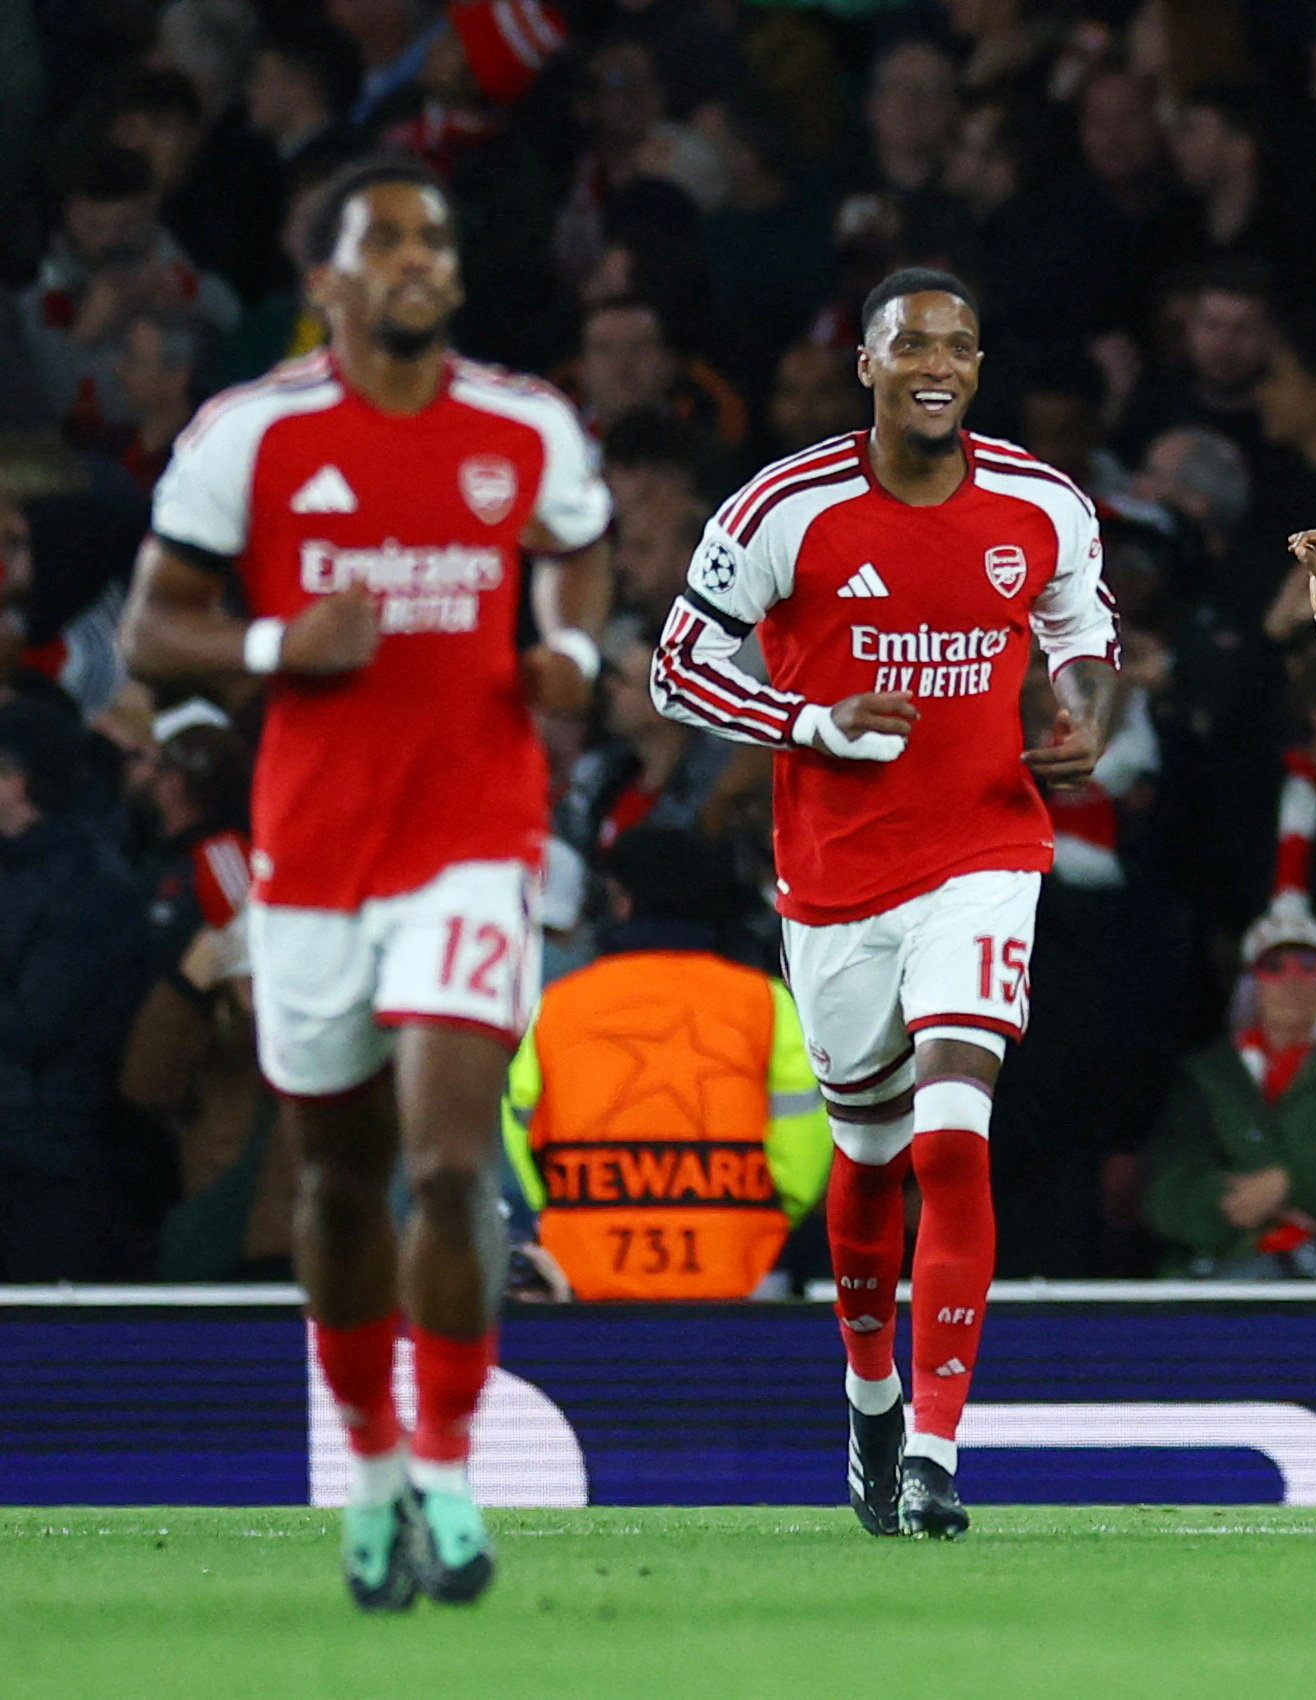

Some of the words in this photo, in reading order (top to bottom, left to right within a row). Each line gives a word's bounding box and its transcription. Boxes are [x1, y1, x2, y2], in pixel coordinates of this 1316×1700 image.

[850, 622, 1011, 663] Emirates
[918, 661, 992, 698] BETTER
[439, 915, 508, 998] 12
[973, 934, 1031, 1005] 15
[607, 1227, 703, 1274] 731
